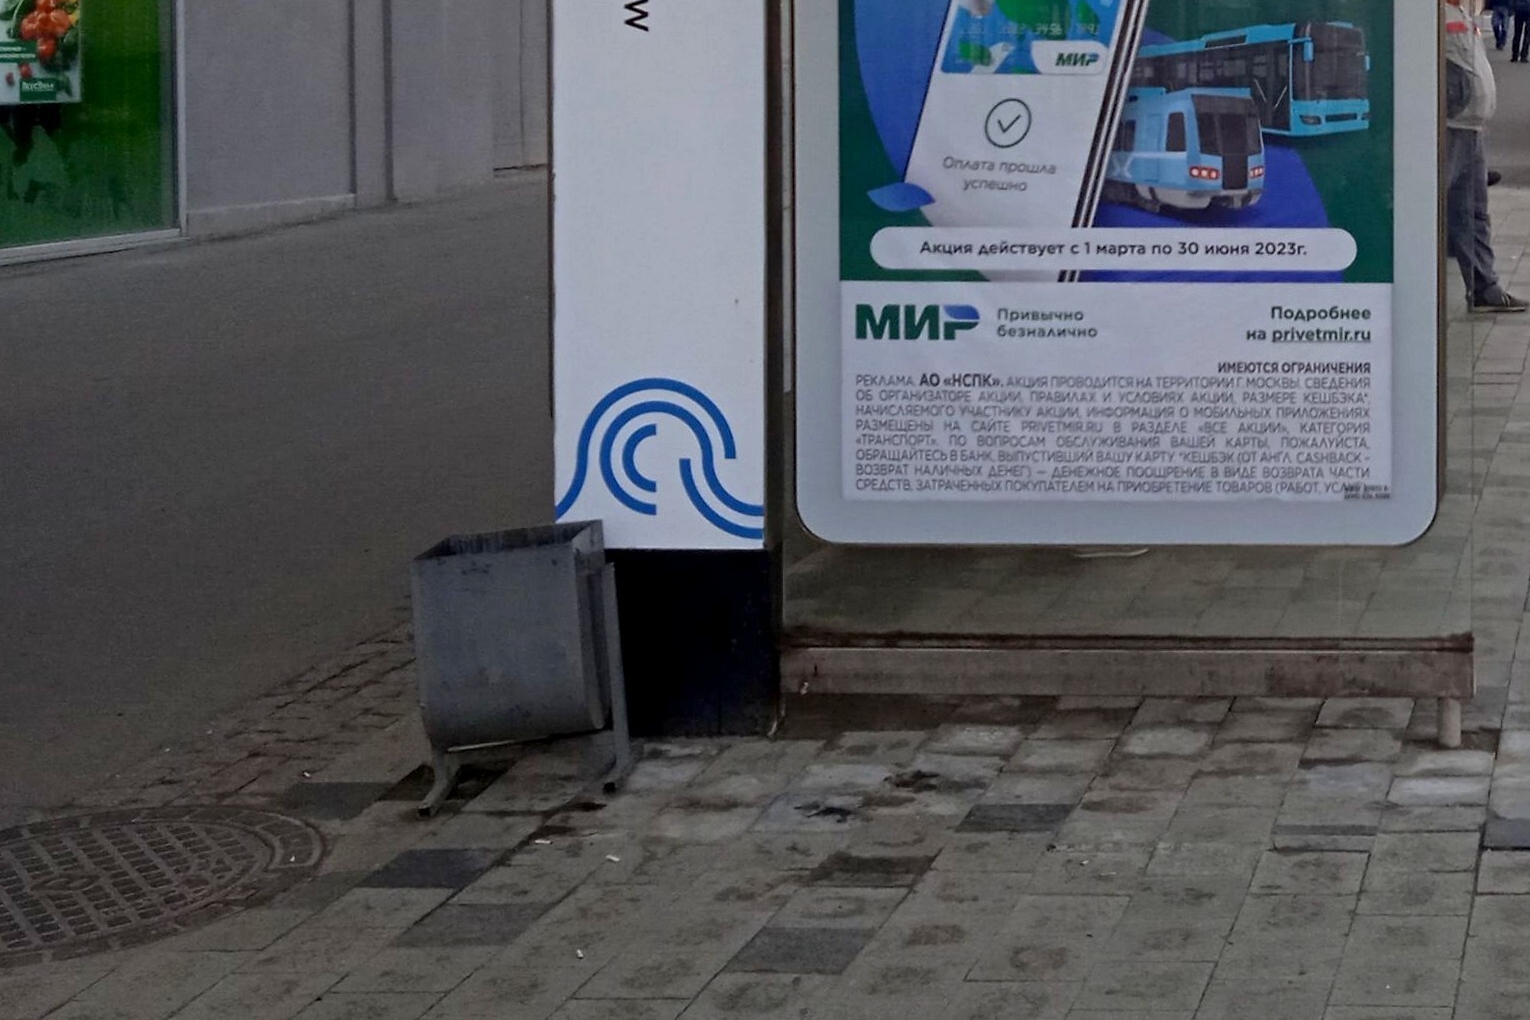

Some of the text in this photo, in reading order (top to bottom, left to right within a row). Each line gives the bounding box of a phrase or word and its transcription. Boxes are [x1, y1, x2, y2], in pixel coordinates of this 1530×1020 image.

[1056, 52, 1100, 67] МИР
[943, 155, 1057, 178] Оплата прошла
[963, 177, 1027, 193] успешно
[920, 240, 1307, 260] Акция действует с 1 марта по 30 июня 2023г.
[997, 308, 1083, 323] Привычно
[1271, 306, 1371, 322] Подробнее
[856, 305, 980, 340] МИР
[997, 325, 1097, 338] безналично
[1247, 327, 1371, 343] на privetmir.ru
[1218, 362, 1370, 374] ИМЕЮТСЯ ОГРАНИЧЕНИЯ
